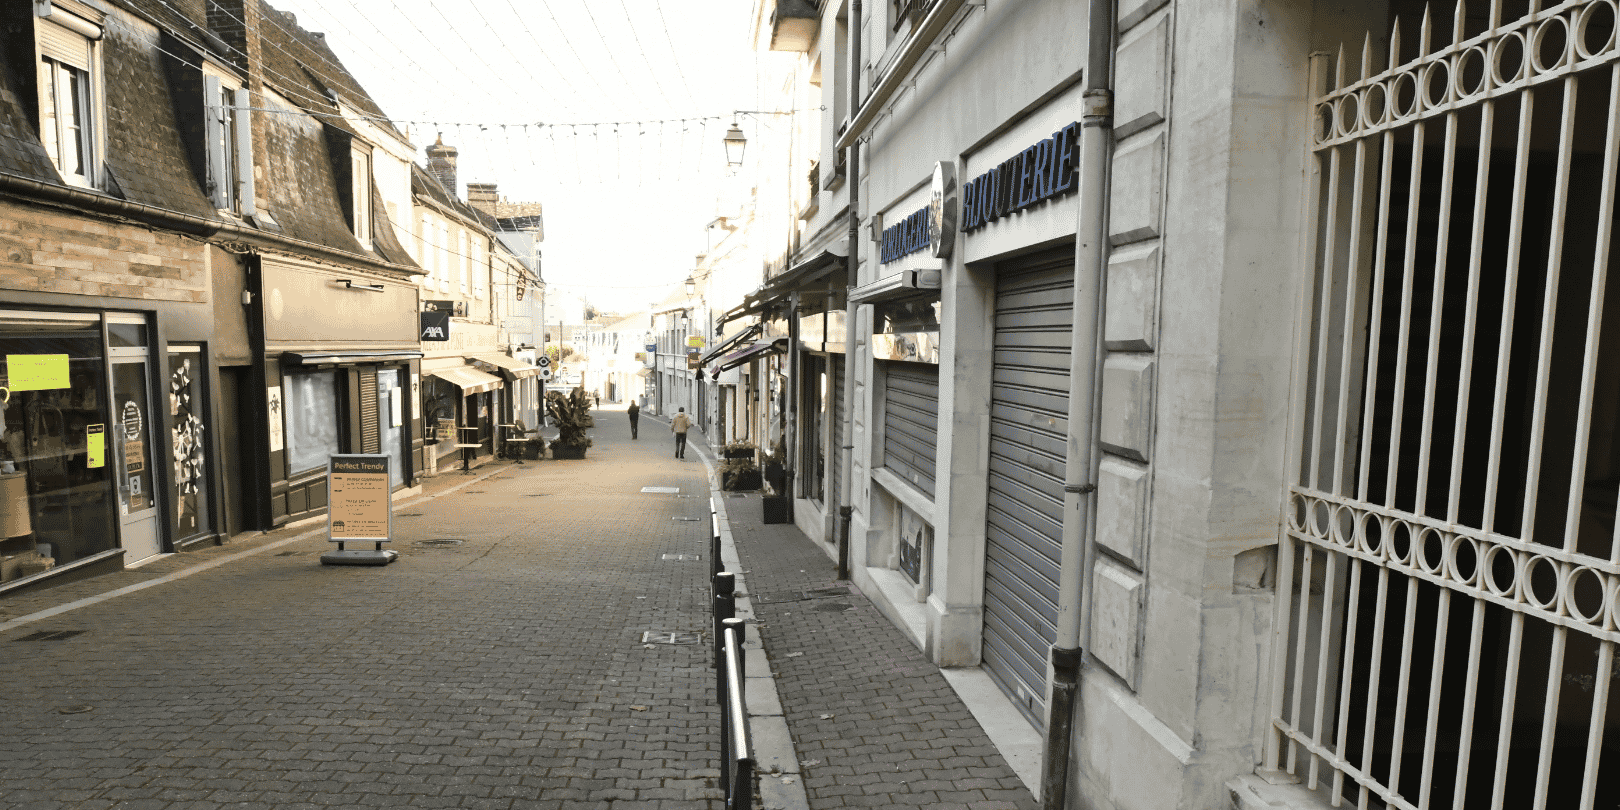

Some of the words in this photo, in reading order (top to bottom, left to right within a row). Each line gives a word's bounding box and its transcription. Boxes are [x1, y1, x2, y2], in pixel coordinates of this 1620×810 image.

[961, 121, 1078, 231] BIJOUTERIE
[421, 326, 444, 338] AXA
[334, 462, 360, 470] Perfect
[361, 462, 385, 471] Trendy
